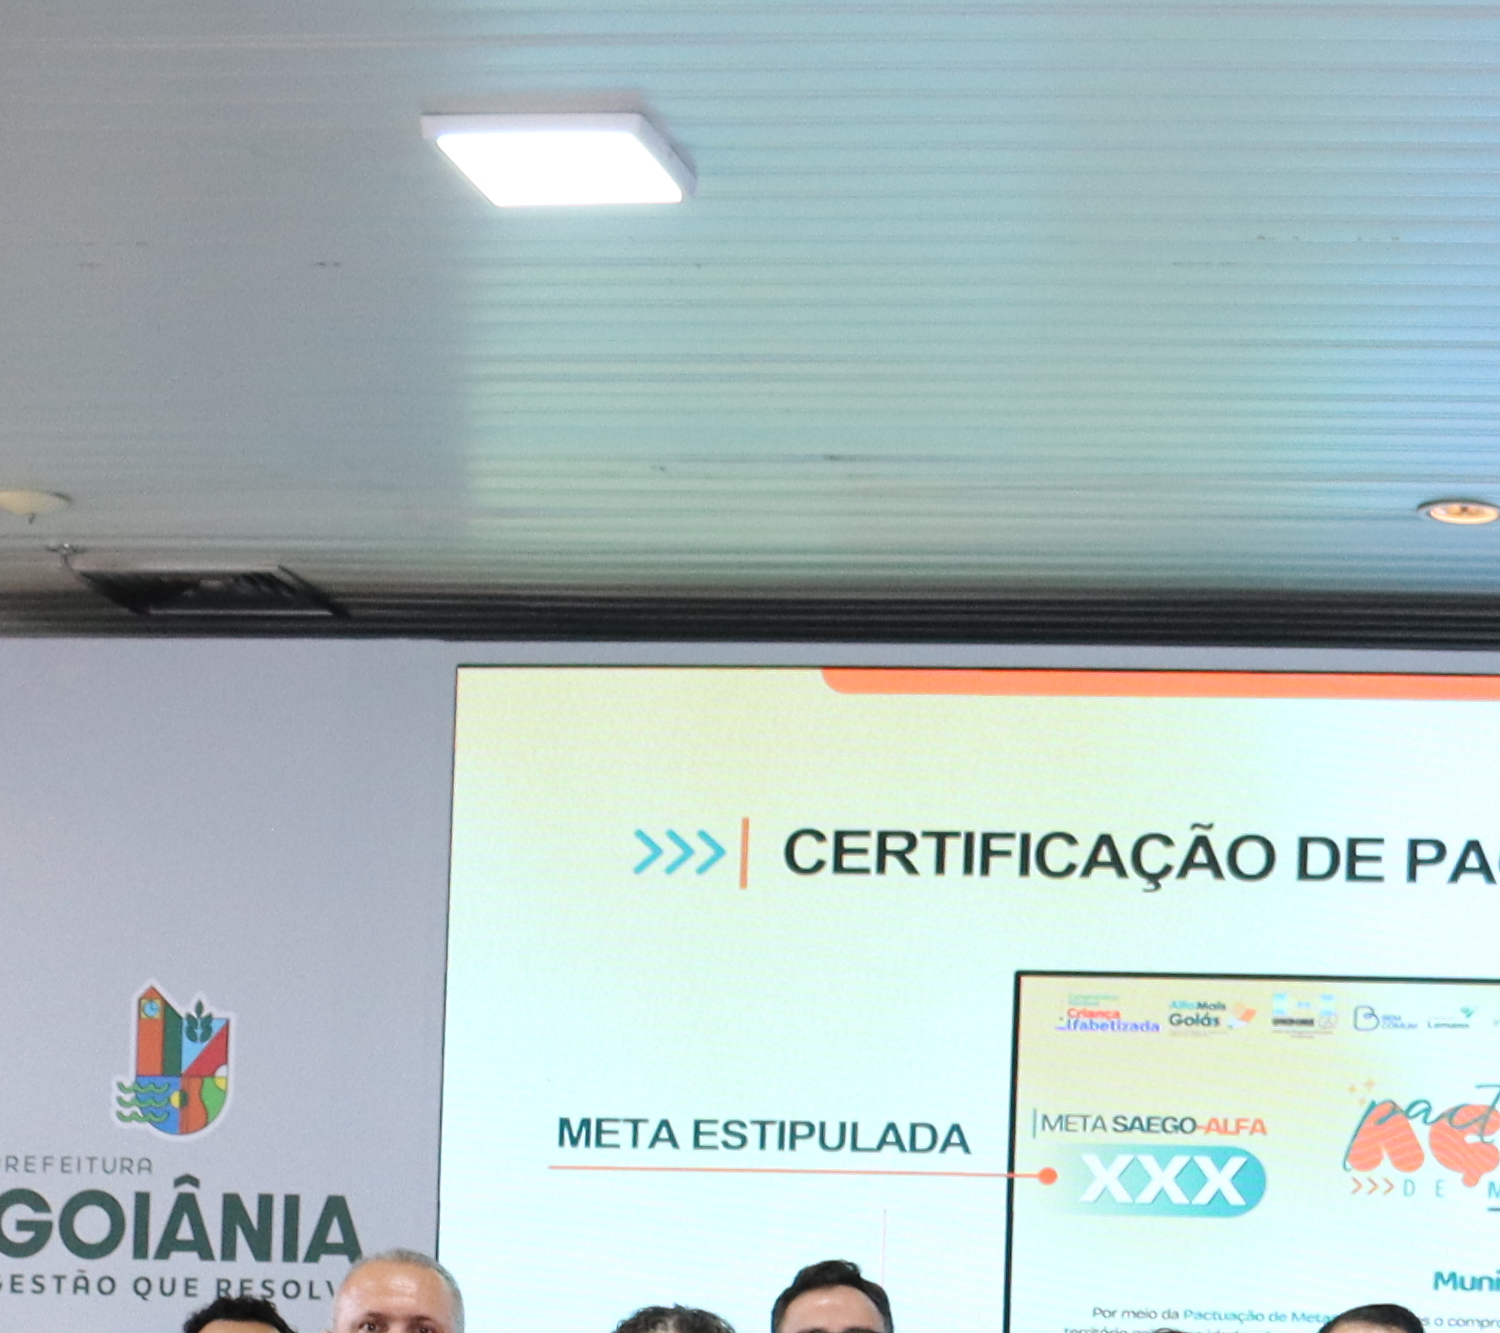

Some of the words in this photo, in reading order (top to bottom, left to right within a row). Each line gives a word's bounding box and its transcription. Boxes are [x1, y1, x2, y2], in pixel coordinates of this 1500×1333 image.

[783, 822, 1276, 893] CERTIFICAÇÃO
[1297, 836, 1385, 882] DE
[1056, 1017, 1160, 1033] lfabetizada
[1169, 1011, 1221, 1028] Goiás
[558, 1117, 681, 1150] META
[693, 1119, 972, 1155] ESTIPULADA
[1041, 1113, 1108, 1133] META
[1112, 1115, 1268, 1136] SAEGO-ALFA
[1080, 1153, 1248, 1206] XXX
[1402, 1179, 1446, 1198] DE
[132, 1277, 199, 1301] QUE
[1092, 1306, 1118, 1320] Por
[1122, 1307, 1155, 1321] meio
[1161, 1307, 1180, 1321] da
[1184, 1309, 1265, 1326] Pactuação
[1268, 1310, 1288, 1323] de
